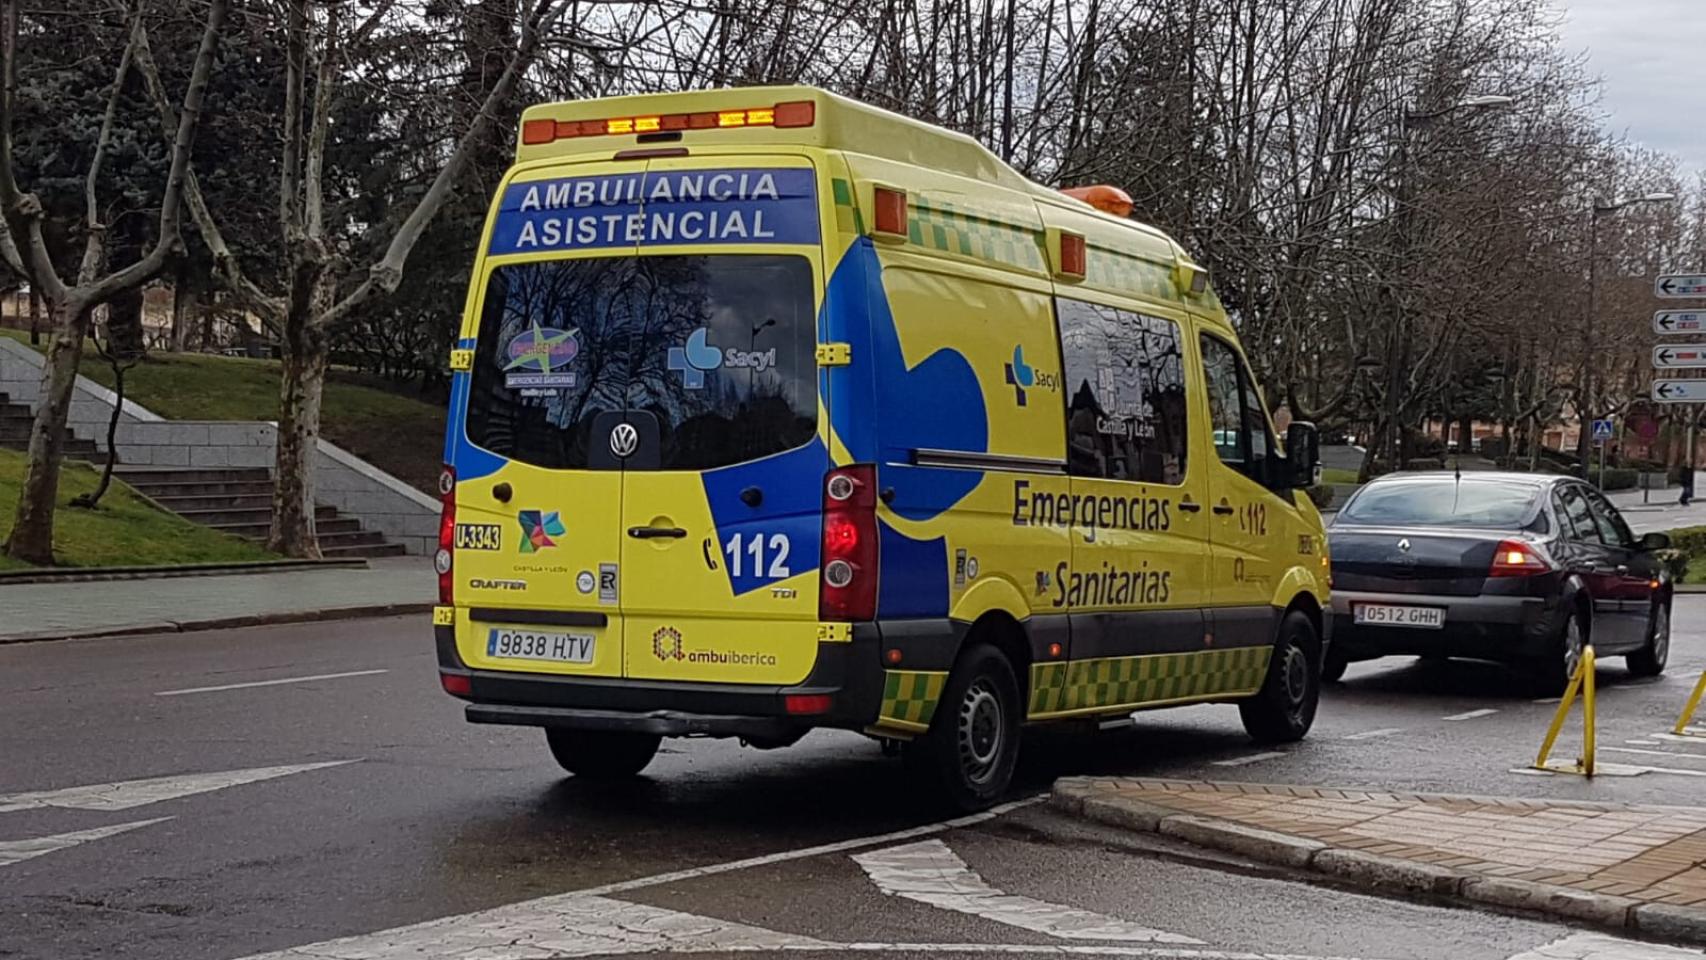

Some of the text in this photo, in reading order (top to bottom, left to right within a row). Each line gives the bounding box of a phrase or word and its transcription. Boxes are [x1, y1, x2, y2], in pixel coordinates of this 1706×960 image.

[515, 209, 776, 248] ASISTENCIAL
[725, 347, 776, 371] Sacyl
[1034, 369, 1061, 393] Sacyl
[1012, 480, 1171, 543] Emergencias
[1248, 503, 1266, 535] 112
[457, 526, 499, 548] U-3343
[726, 532, 790, 577] 112
[469, 579, 527, 590] CRAFTER
[771, 587, 797, 599] TDI
[1053, 561, 1171, 607] Sanitarias
[1367, 607, 1438, 624] 0512 GHH
[500, 634, 590, 659] 9838 HTV
[689, 650, 776, 666] ambuiberica
